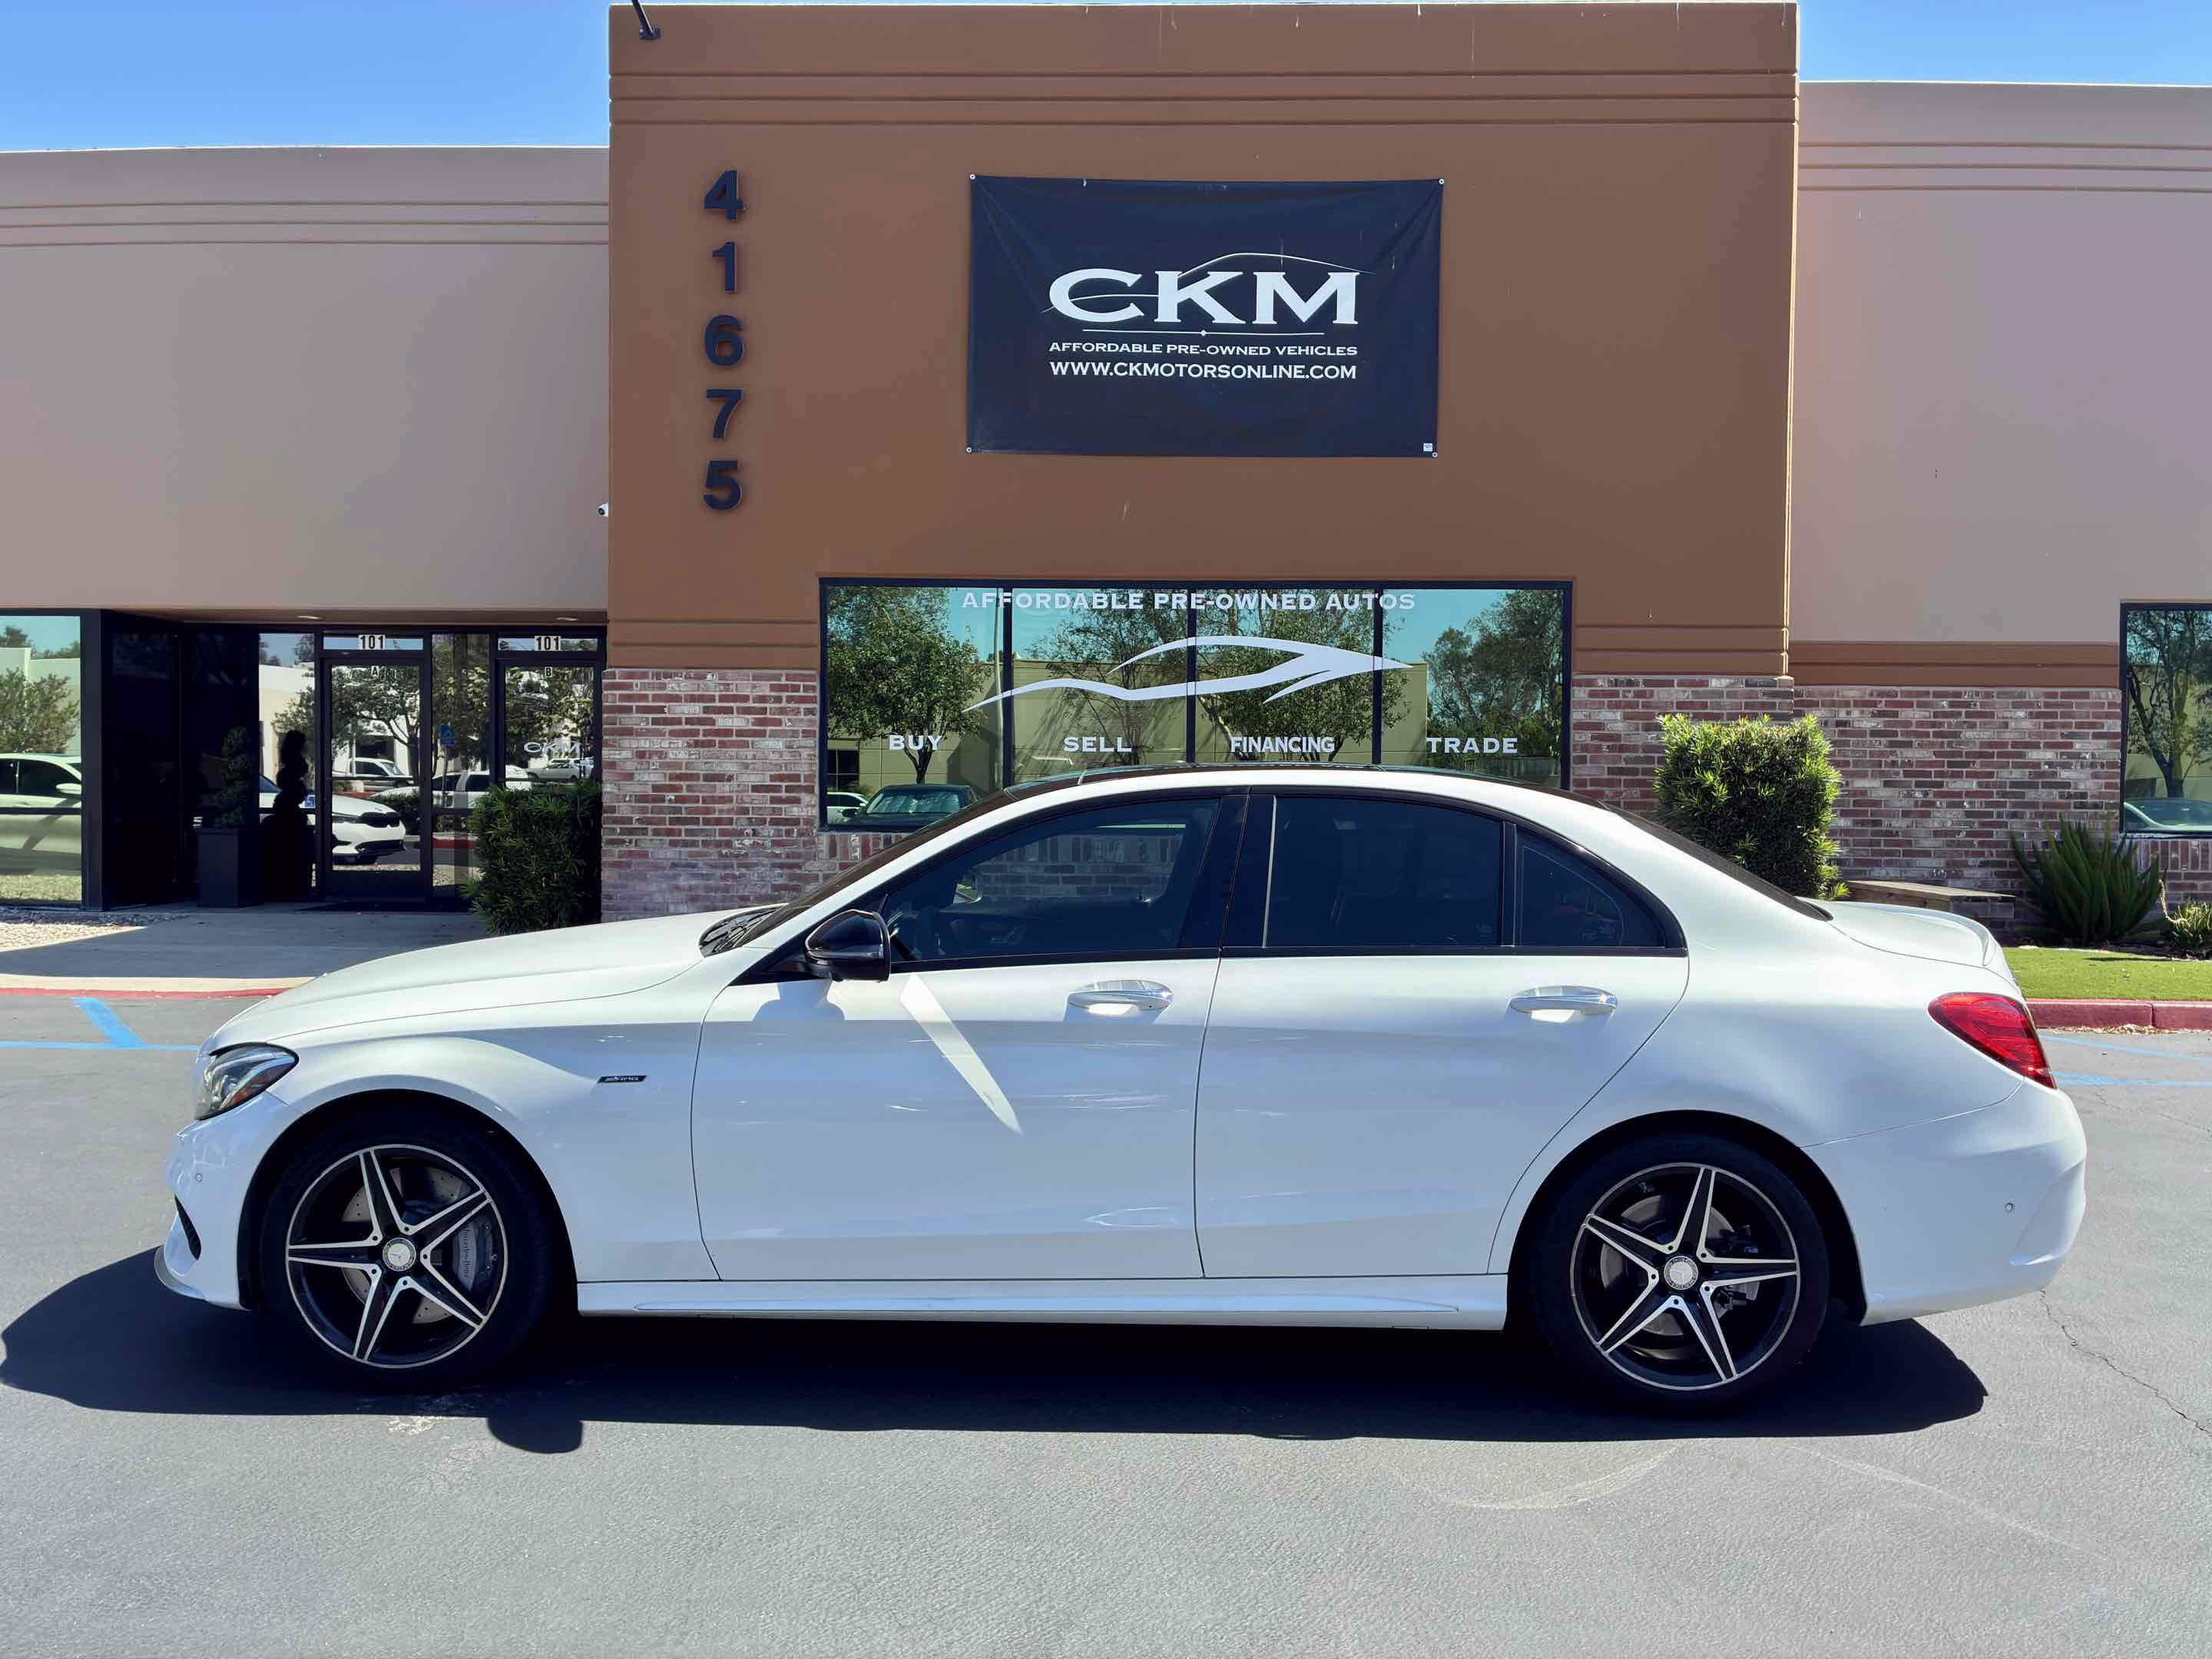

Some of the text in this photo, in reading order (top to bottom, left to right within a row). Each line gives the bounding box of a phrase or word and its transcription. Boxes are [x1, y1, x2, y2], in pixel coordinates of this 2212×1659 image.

[1049, 268, 1360, 325] CKM
[704, 170, 744, 511] 41675
[1049, 342, 1358, 356] AFFORDABLE PRE-OWNED VEHICLES
[1050, 361, 1357, 379] WWW.CKMOTORSONLINE.COM
[962, 591, 1416, 610] AFFORDABLE PRE-OWNED AUTOS
[359, 636, 385, 649] 101
[536, 637, 561, 650] 101
[889, 735, 944, 750] BUY
[1063, 737, 1131, 752] SELL
[1230, 737, 1335, 753] FINANCING
[1426, 737, 1518, 753] TRADE
